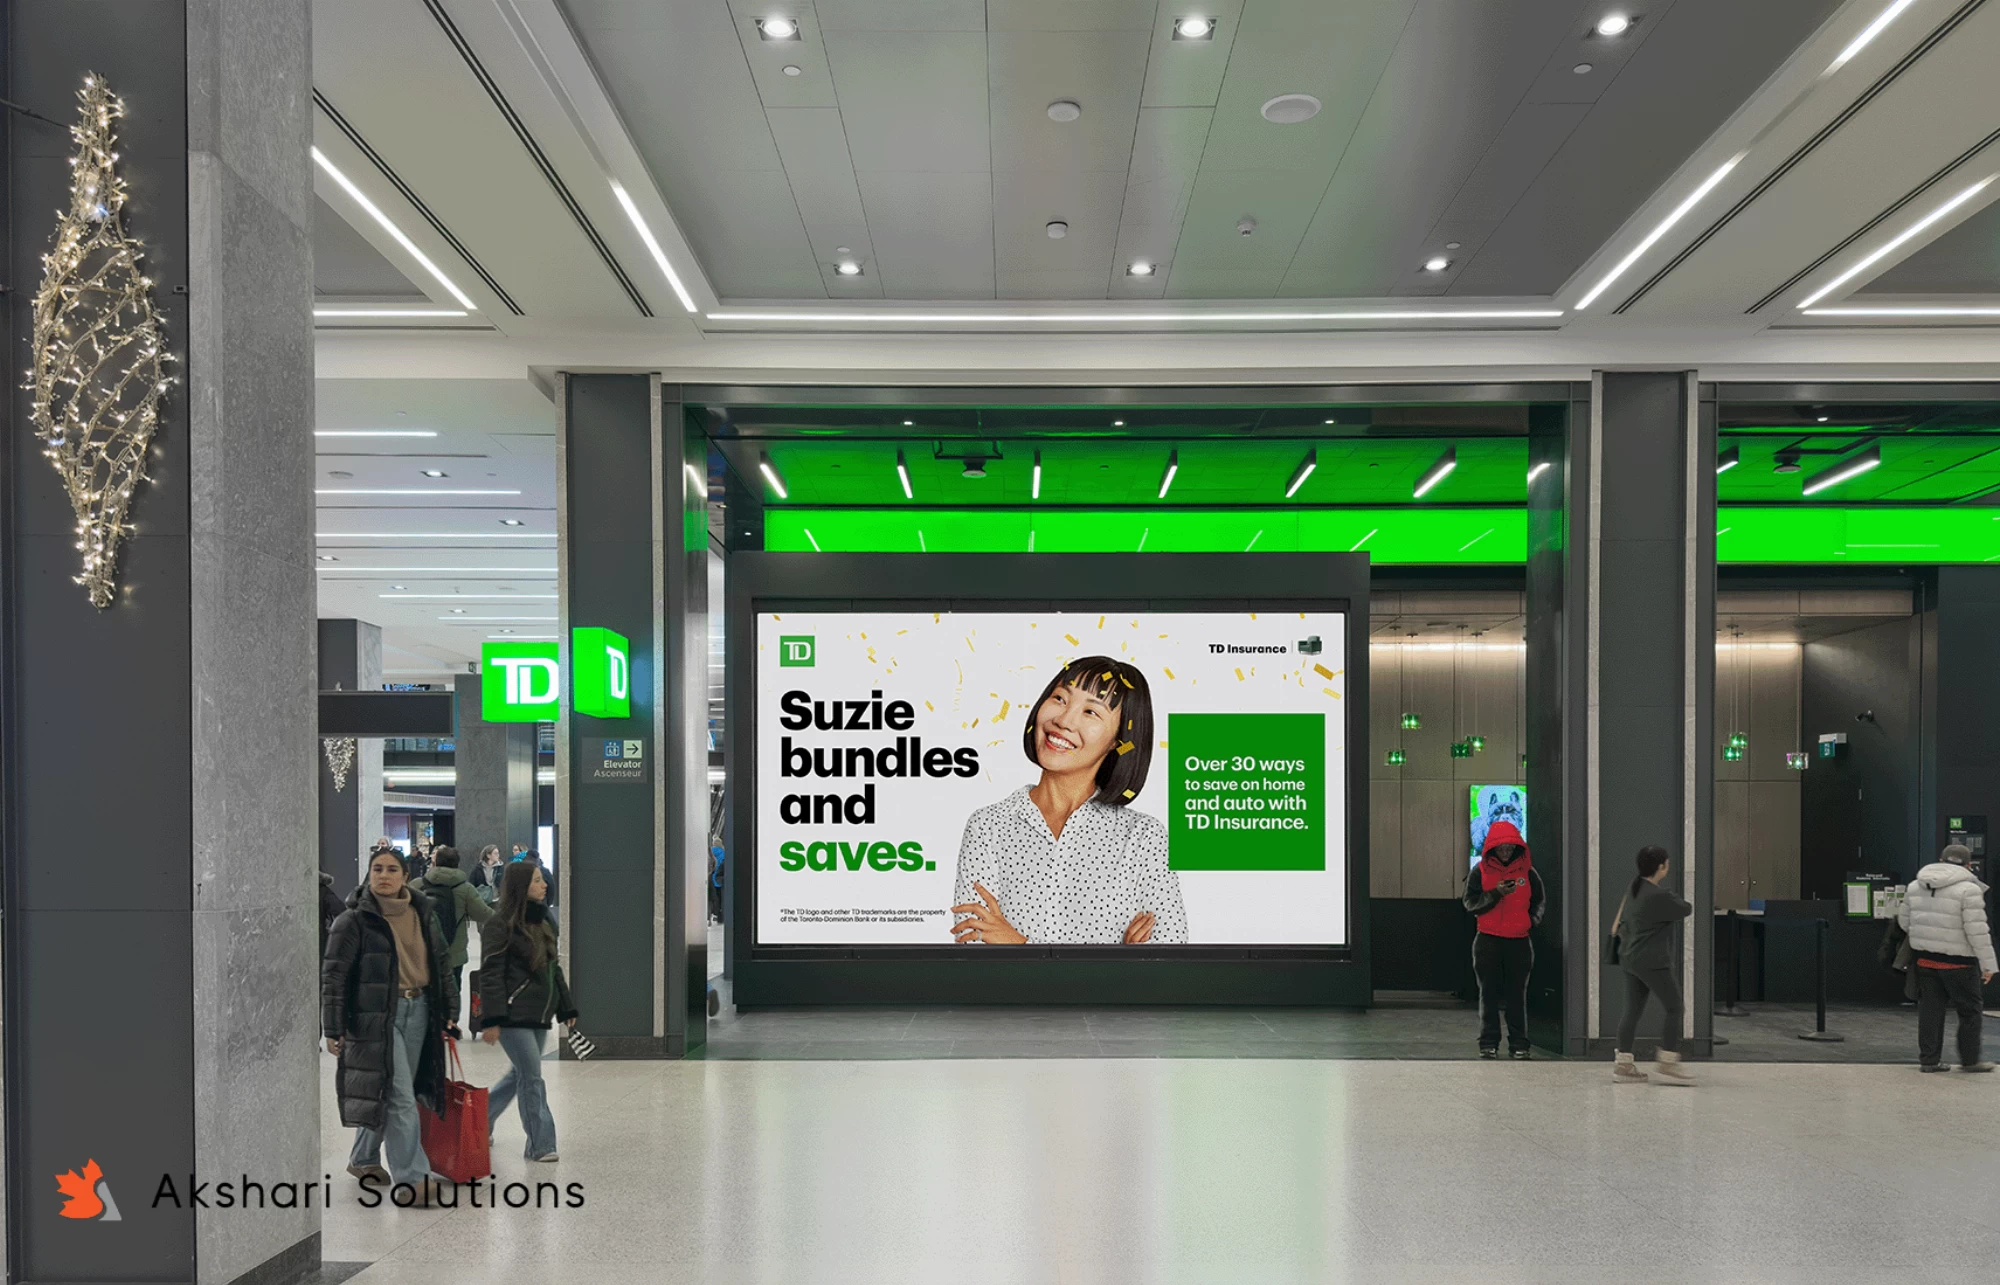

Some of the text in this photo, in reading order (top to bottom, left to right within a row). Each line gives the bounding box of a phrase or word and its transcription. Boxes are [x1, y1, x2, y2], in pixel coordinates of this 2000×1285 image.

[783, 641, 812, 661] TD
[1208, 644, 1287, 654] TD Insurance
[491, 657, 559, 705] TD
[606, 645, 627, 700] TD
[779, 689, 915, 731] Suzie
[603, 759, 642, 769] Elevator
[780, 736, 980, 778] bundles
[1184, 756, 1305, 774] Over 30 ways
[593, 769, 642, 778] Ascenseur
[1184, 778, 1306, 791] to save on home
[779, 783, 875, 825] and
[1184, 794, 1307, 811] and auto with
[1184, 814, 1309, 830] TD Insurance.
[779, 840, 936, 872] saves.
[806, 908, 820, 917] logo
[920, 908, 946, 917] property
